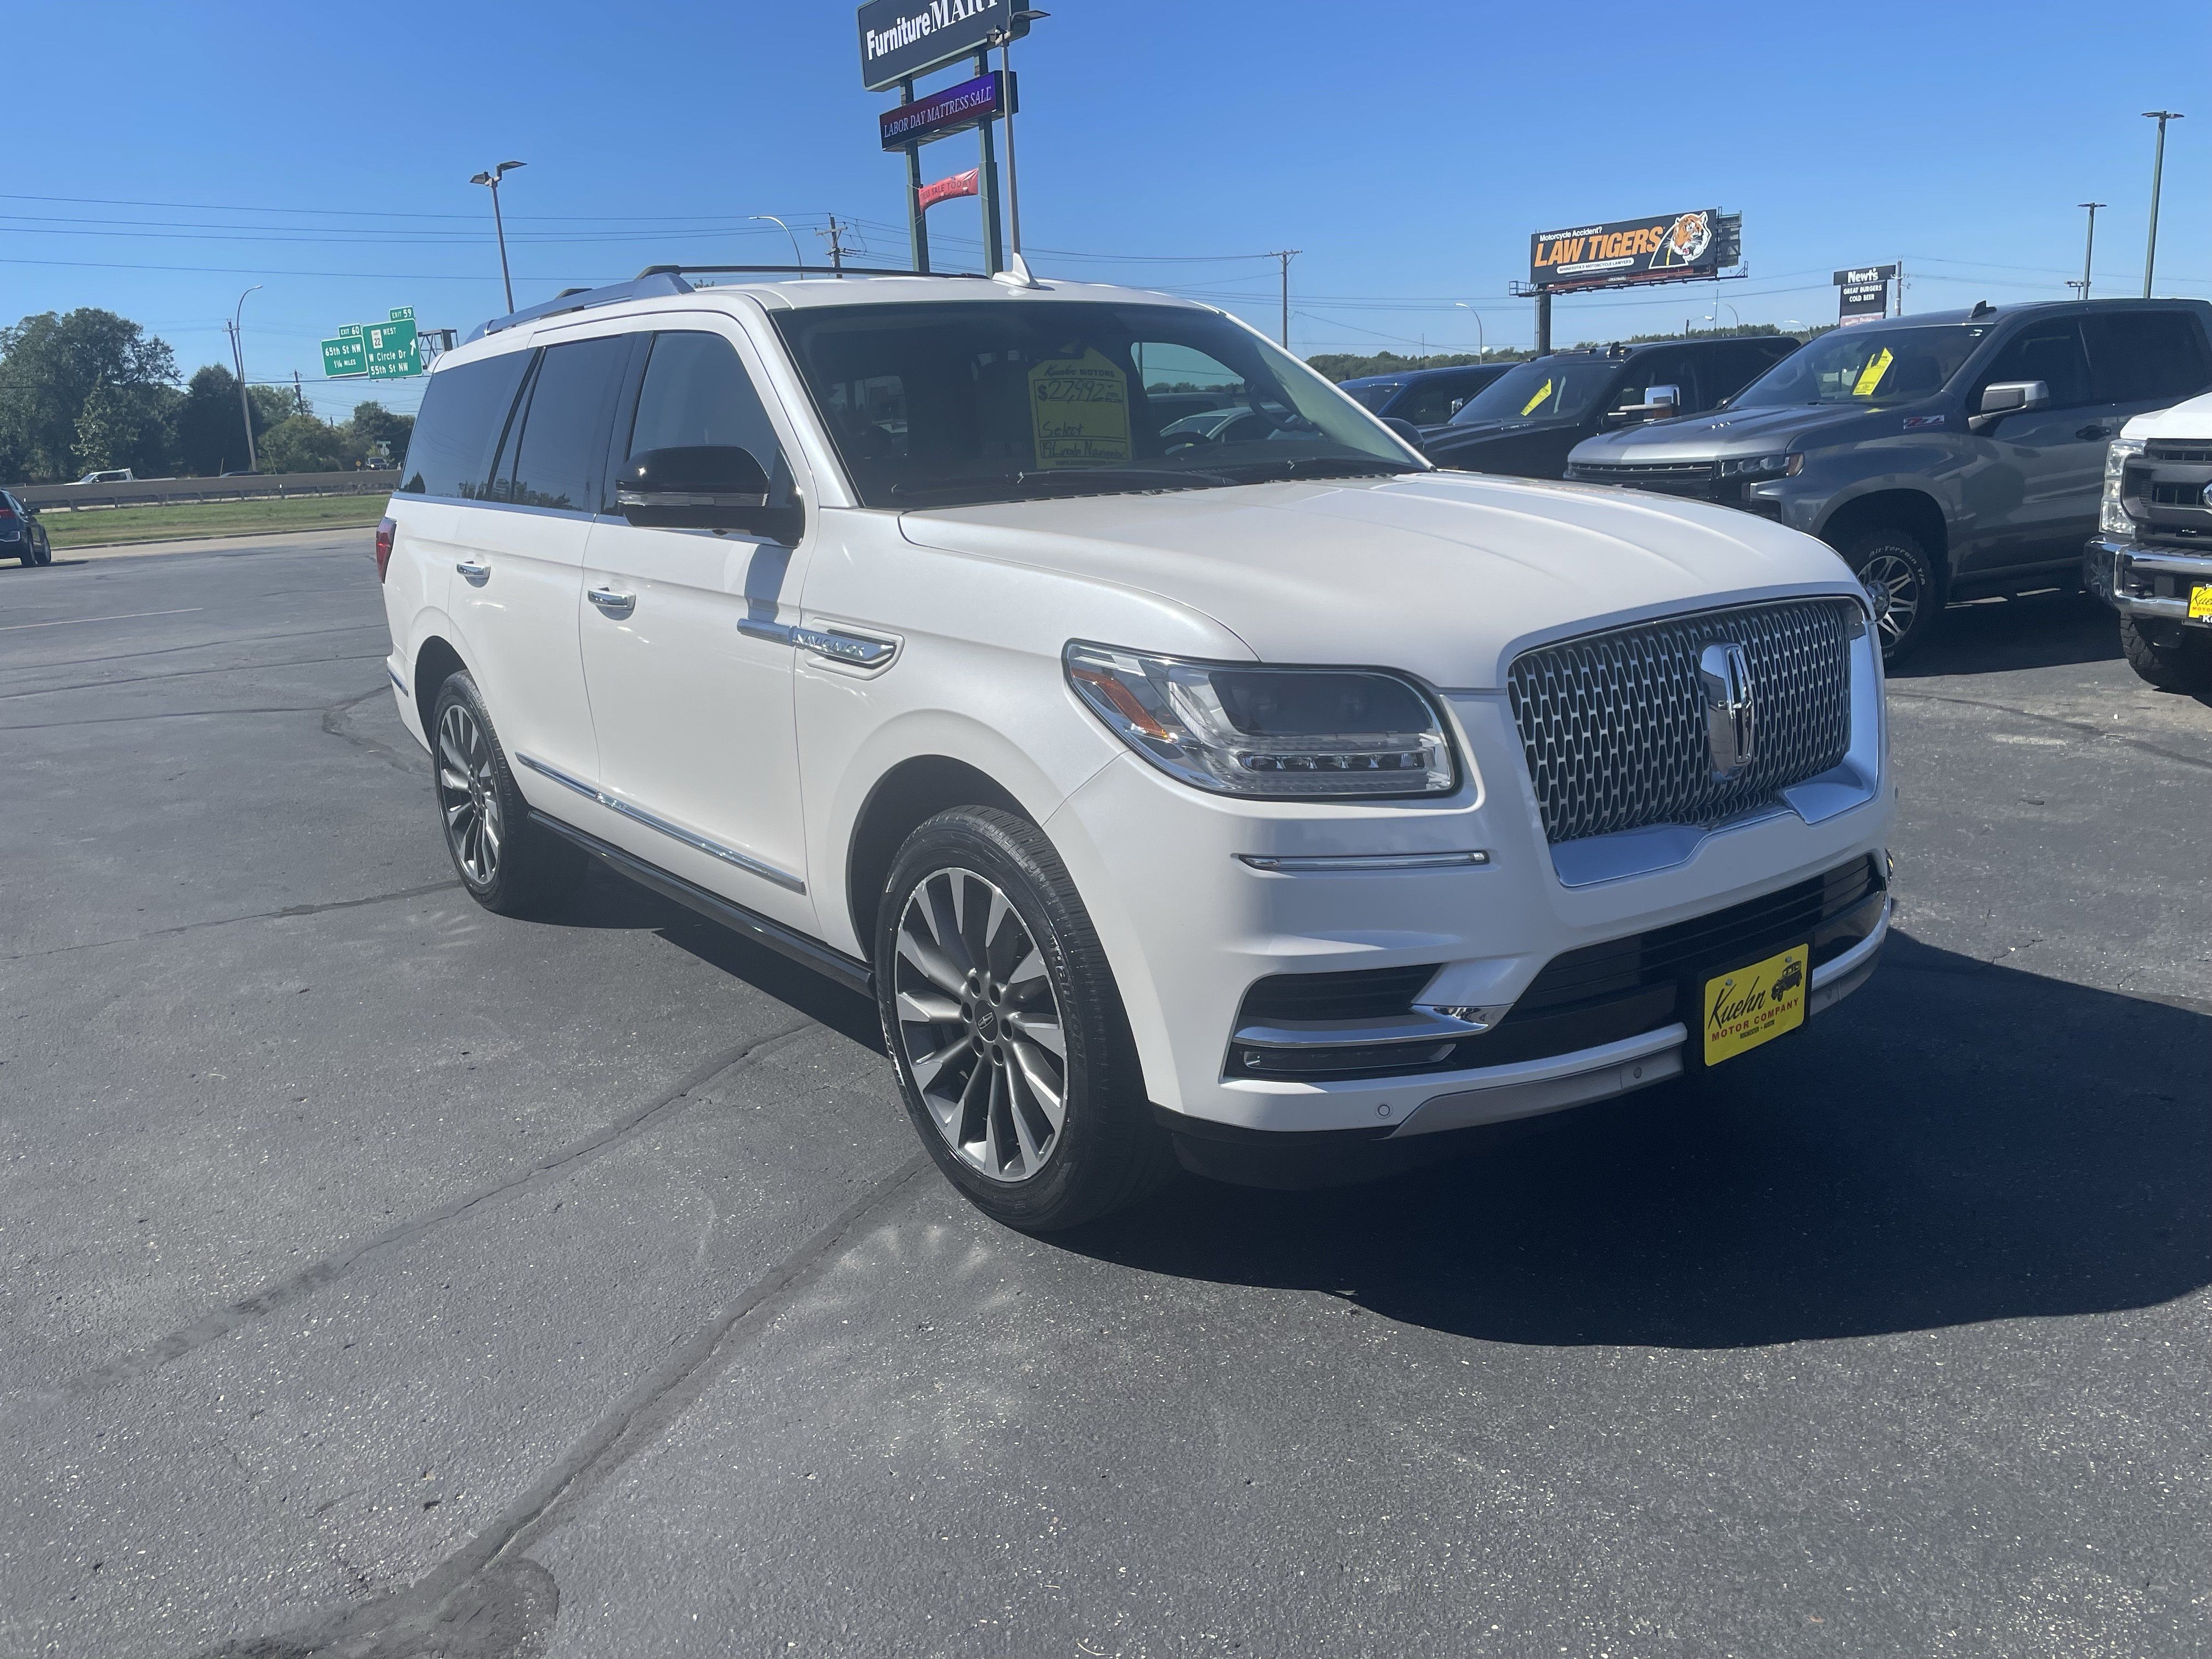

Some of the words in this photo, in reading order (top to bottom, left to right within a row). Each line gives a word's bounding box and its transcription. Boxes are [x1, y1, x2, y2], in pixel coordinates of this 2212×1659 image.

[884, 117, 909, 138] LABOR
[910, 110, 926, 129] DAY
[927, 94, 969, 122] MATTRESS
[970, 86, 992, 106] SALE
[931, 184, 945, 196] SALE
[947, 179, 972, 190] TODAY
[1539, 230, 1572, 242] Motorcycle
[1572, 226, 1603, 236] Accident?
[1534, 237, 1586, 267] LAW
[1588, 226, 1663, 261] TIGERS
[1847, 268, 1878, 283] Newt's
[1843, 286, 1859, 295] GREAT
[1860, 284, 1882, 293] BURGERS
[403, 309, 411, 318] 59
[351, 326, 359, 335] 60
[383, 327, 397, 335] WEST
[374, 338, 381, 346] 22
[325, 346, 340, 357] 65th
[342, 345, 350, 354] St
[351, 343, 362, 353] NW
[369, 354, 374, 363] W
[376, 351, 396, 362] Circle
[398, 349, 406, 359] Dr
[370, 365, 386, 375] 55th
[388, 364, 397, 373] St
[398, 362, 409, 372] NW
[1080, 369, 1115, 378] MOTORS
[2191, 589, 2212, 607] Kue
[797, 634, 865, 657] NAVIGATOR
[1708, 976, 1765, 1030] Kuehn
[1712, 1020, 1749, 1041] MOTOR
[1754, 997, 1799, 1024] COMPANY
